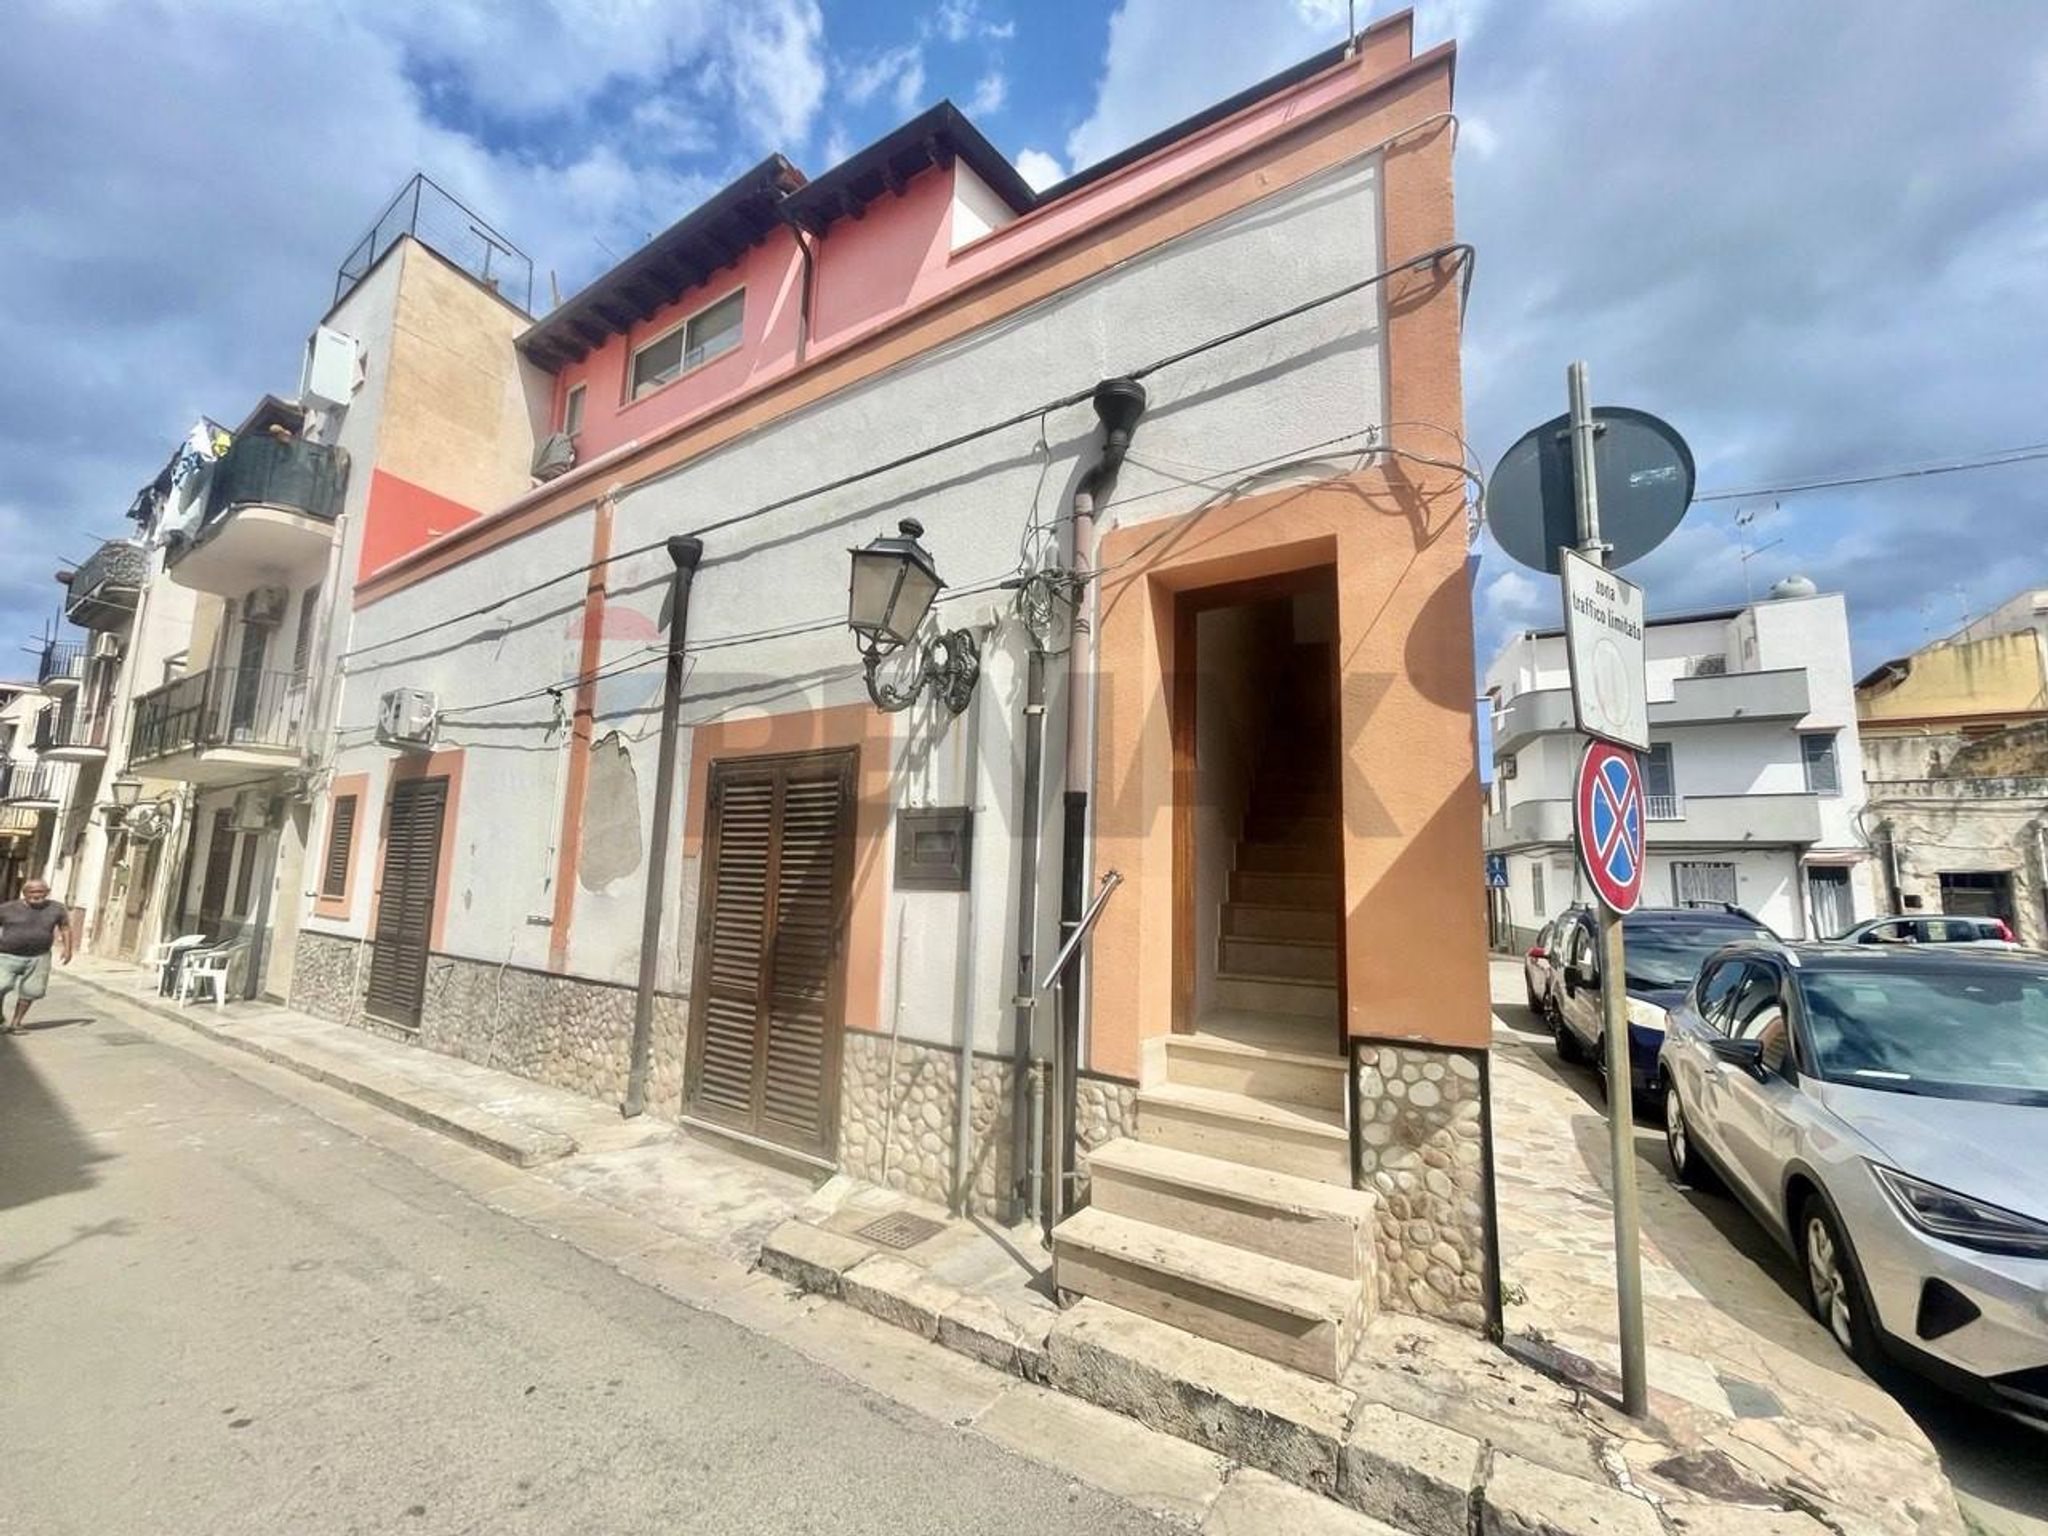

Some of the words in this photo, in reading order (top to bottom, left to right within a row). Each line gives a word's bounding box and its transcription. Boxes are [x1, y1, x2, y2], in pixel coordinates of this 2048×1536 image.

[1595, 579, 1616, 602] zona
[1572, 589, 1606, 624] traffico
[1607, 607, 1642, 641] limitato
